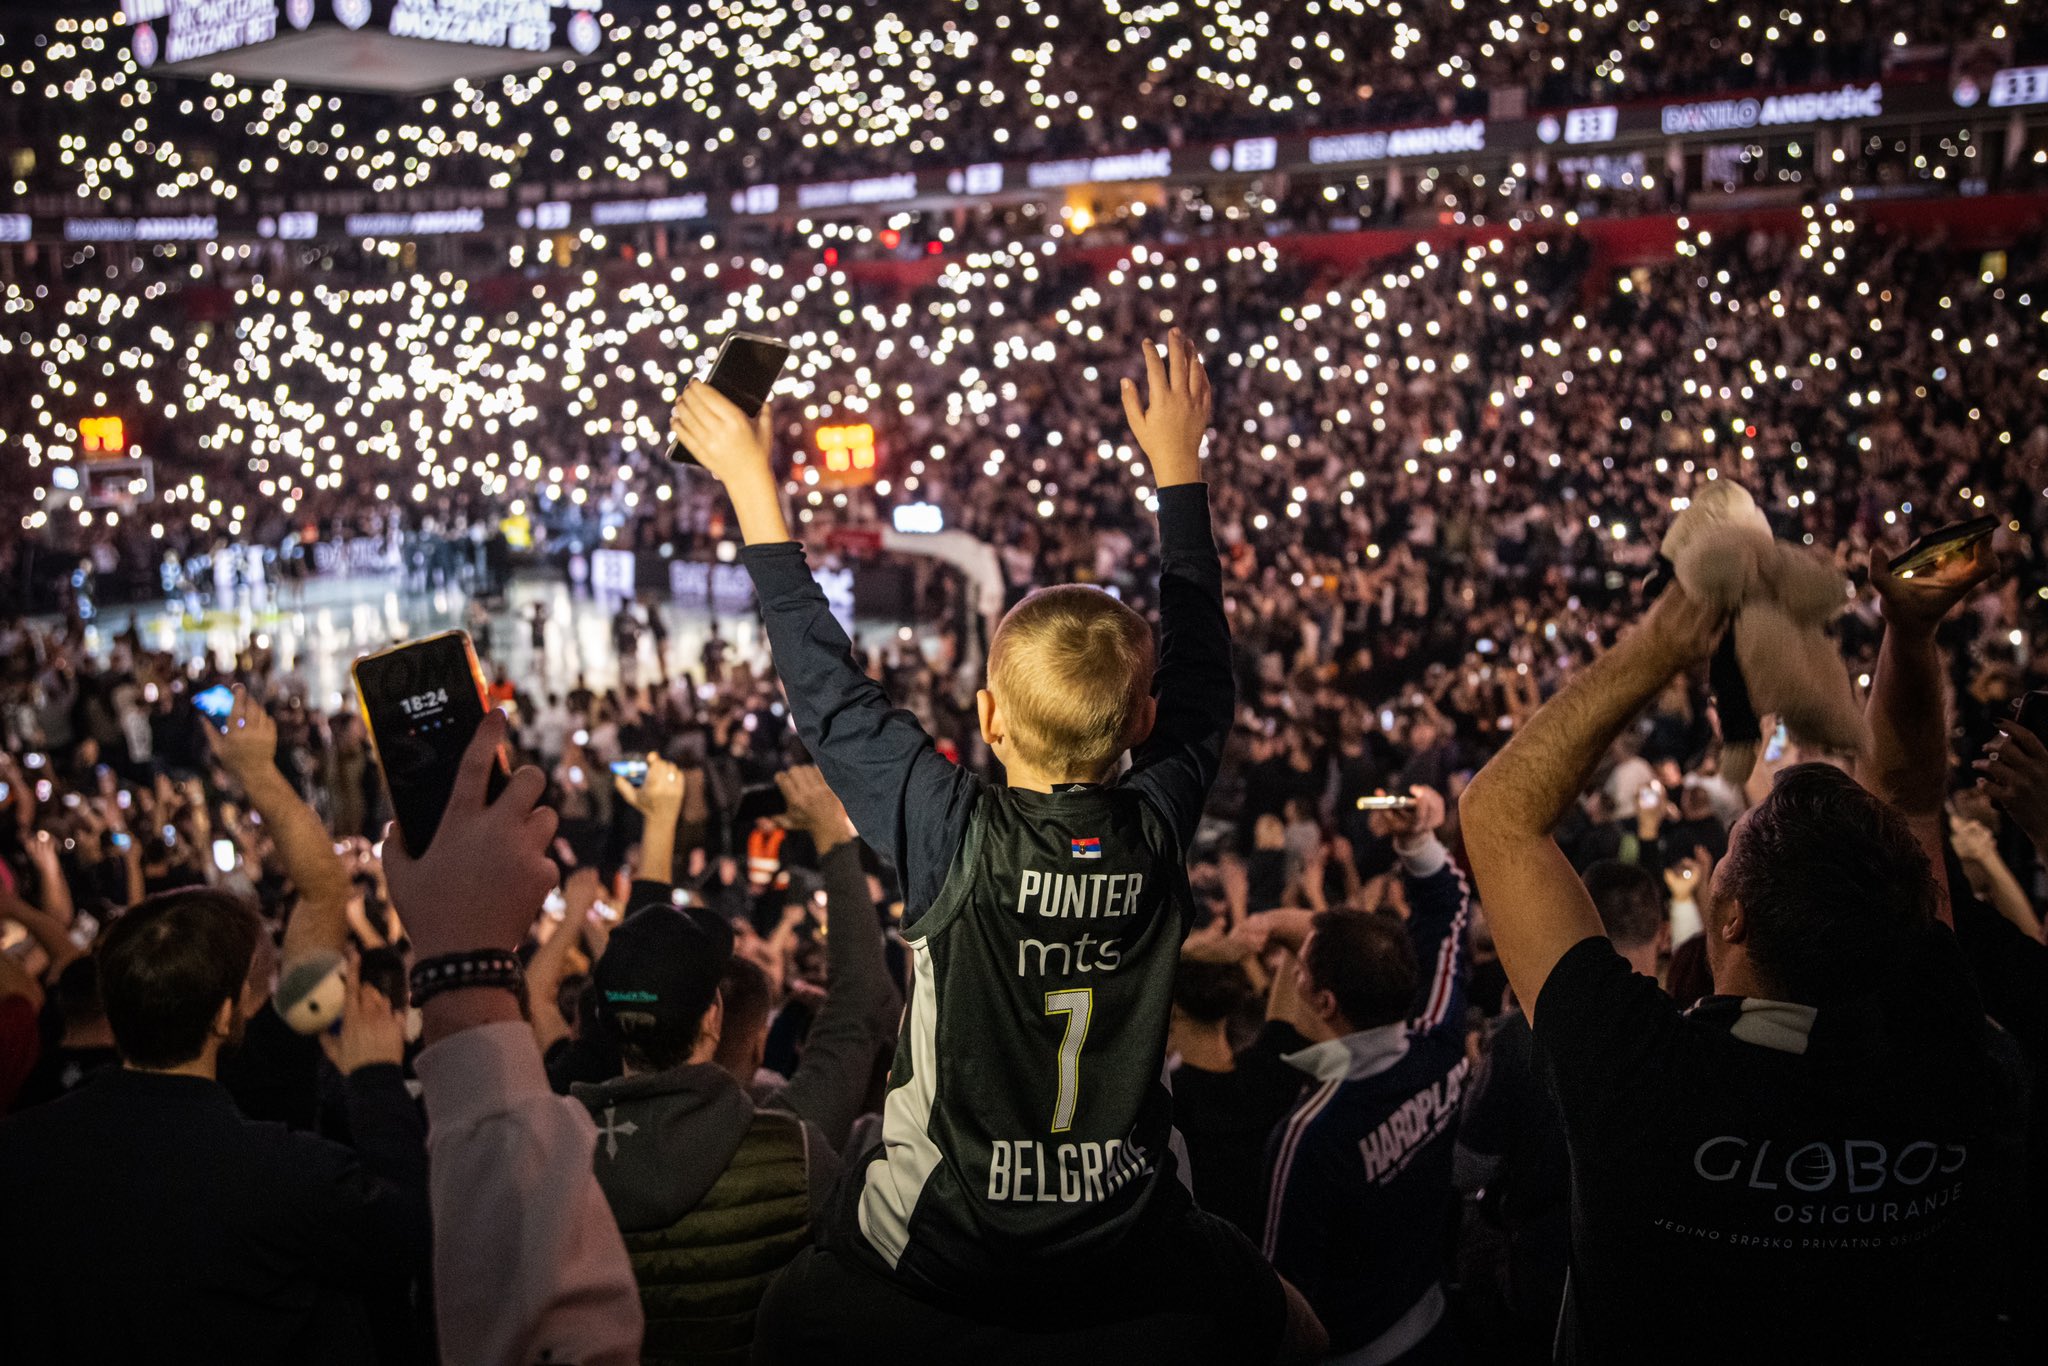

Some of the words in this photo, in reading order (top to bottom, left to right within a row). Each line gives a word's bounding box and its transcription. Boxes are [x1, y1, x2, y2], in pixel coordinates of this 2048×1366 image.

[400, 687, 449, 714] 18:24
[1017, 870, 1143, 919] PUNTER
[1018, 933, 1121, 978] mts
[1044, 987, 1093, 1134] 7
[1773, 1182, 1965, 1224] OSIGURANJE
[1653, 1217, 1720, 1240] JEDINO
[1729, 1234, 1793, 1249] SRPSKO
[1802, 1237, 1881, 1250] PRIVATNO
